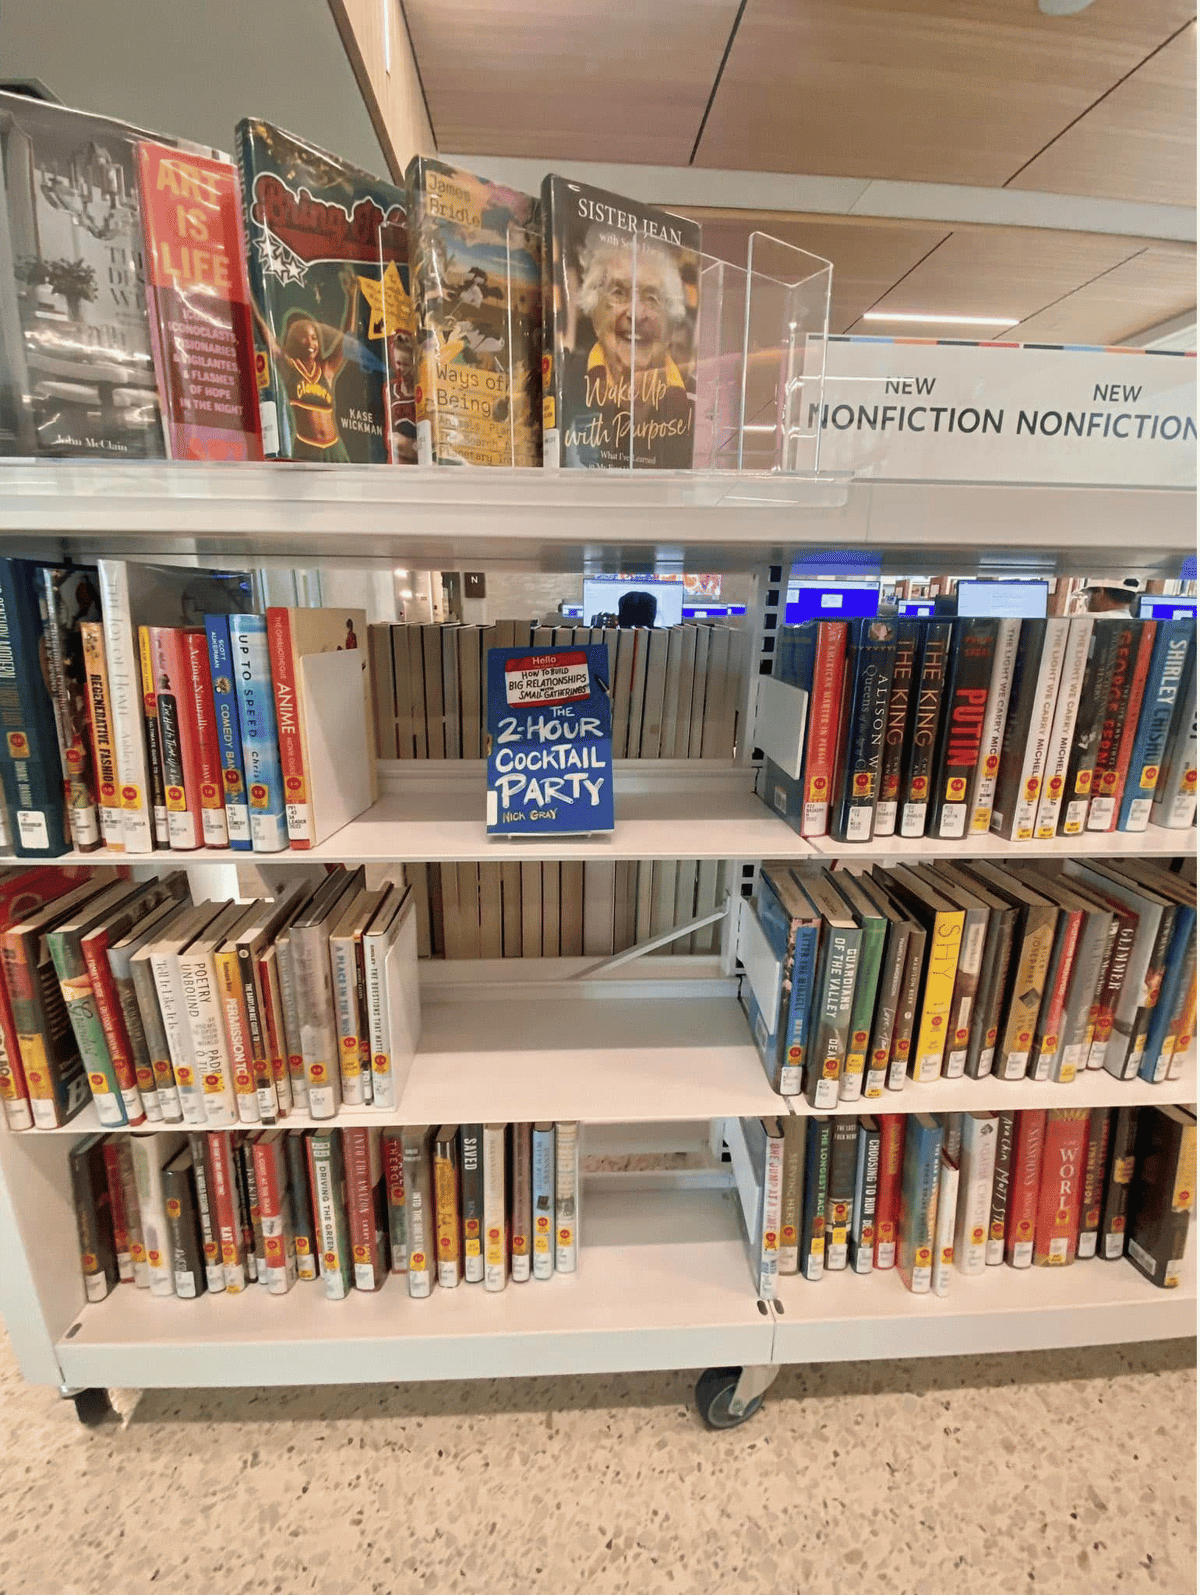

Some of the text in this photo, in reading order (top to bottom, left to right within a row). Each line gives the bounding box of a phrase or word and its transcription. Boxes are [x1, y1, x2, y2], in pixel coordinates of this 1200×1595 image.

[157, 159, 221, 205] ART
[177, 204, 209, 241] IS
[578, 198, 682, 246] SISTER JEAN
[160, 241, 230, 287] LIFE
[188, 384, 232, 400] OF HOPE
[191, 370, 235, 386] FLASHES
[435, 363, 505, 391] Ways of
[584, 369, 668, 410] Wake Up
[884, 376, 936, 395] NEW
[1093, 384, 1143, 402] NEW
[192, 399, 213, 413] THE
[213, 401, 244, 417] NIGHT
[349, 409, 374, 423] KASE
[436, 387, 491, 418] Being
[808, 402, 1004, 434] NONFICTION
[341, 417, 383, 436] WICKMAN
[564, 408, 693, 450] with Purpose!
[1016, 410, 1198, 441] NONFICTION
[56, 434, 129, 453] John McClain
[600, 449, 619, 462] What
[471, 576, 478, 584] N
[211, 631, 220, 668] AUKERMAN
[218, 639, 227, 661] SCOTT
[532, 655, 557, 665] Hello
[238, 634, 258, 738] UP TO SPEED
[508, 673, 587, 691] BIG RELATIONSHIPS
[521, 667, 569, 681] HOW TO BUILD
[993, 628, 1016, 735] THE LIGHT WE CARRY
[1038, 628, 1064, 736] THE LIGHT WE CARRY
[1062, 628, 1088, 735] THE LIGHT WE CARRY
[1156, 639, 1188, 705] SHIRLEY
[189, 648, 207, 730] Acting Naturally
[518, 684, 588, 700] SMALL GATHERINGS
[861, 664, 878, 713] Queens
[886, 640, 916, 746] THE KING
[914, 640, 944, 748] THE KING
[276, 682, 296, 734] ANIME
[549, 706, 575, 718] THE
[871, 673, 889, 745] ALISON
[90, 673, 114, 783] REGENERATIVE FASHIO
[220, 703, 234, 748] COMEDY
[497, 715, 604, 744] 2-HOUR
[947, 688, 988, 767] PUTIN
[495, 743, 607, 773] COCKTAIL
[494, 772, 605, 809] PARTY
[502, 807, 558, 824] NICK GRAY
[155, 959, 169, 977] Tell
[890, 937, 905, 997] PAMELA ANDERSON
[932, 923, 962, 981] SHY
[1107, 928, 1134, 991] GLIMMER
[159, 978, 170, 988] It
[193, 962, 212, 1003] POETRY
[336, 955, 347, 983] PLACE
[825, 937, 846, 1019] OF THE VALLEY
[839, 948, 857, 1011] GUARDIANS
[909, 956, 920, 987] MADISON
[161, 989, 173, 1011] Like
[180, 963, 200, 1018] UNBOUND
[339, 986, 348, 996] IN
[166, 1010, 178, 1020] It
[339, 1003, 349, 1019] THE
[370, 968, 383, 1054] THE QUESTIONS THAT MATTE
[225, 997, 246, 1063] PERMISSION
[1003, 1116, 1013, 1137] Ava
[353, 1134, 365, 1156] INTO
[463, 1137, 478, 1171] SAVED
[1000, 1138, 1012, 1161] Chin
[355, 1160, 366, 1175] THE
[767, 1162, 779, 1188] JUMP
[816, 1127, 829, 1216] THE LONGEST RACE
[863, 1139, 880, 1215] CHOOSING TO RUN
[1059, 1147, 1081, 1209] WORL
[1084, 1140, 1097, 1204] LYNNE OLSON
[318, 1165, 335, 1251] DRIVING THE GREEN
[357, 1180, 369, 1213] AMAZON
[412, 1191, 422, 1208] INTO
[412, 1209, 423, 1220] THE
